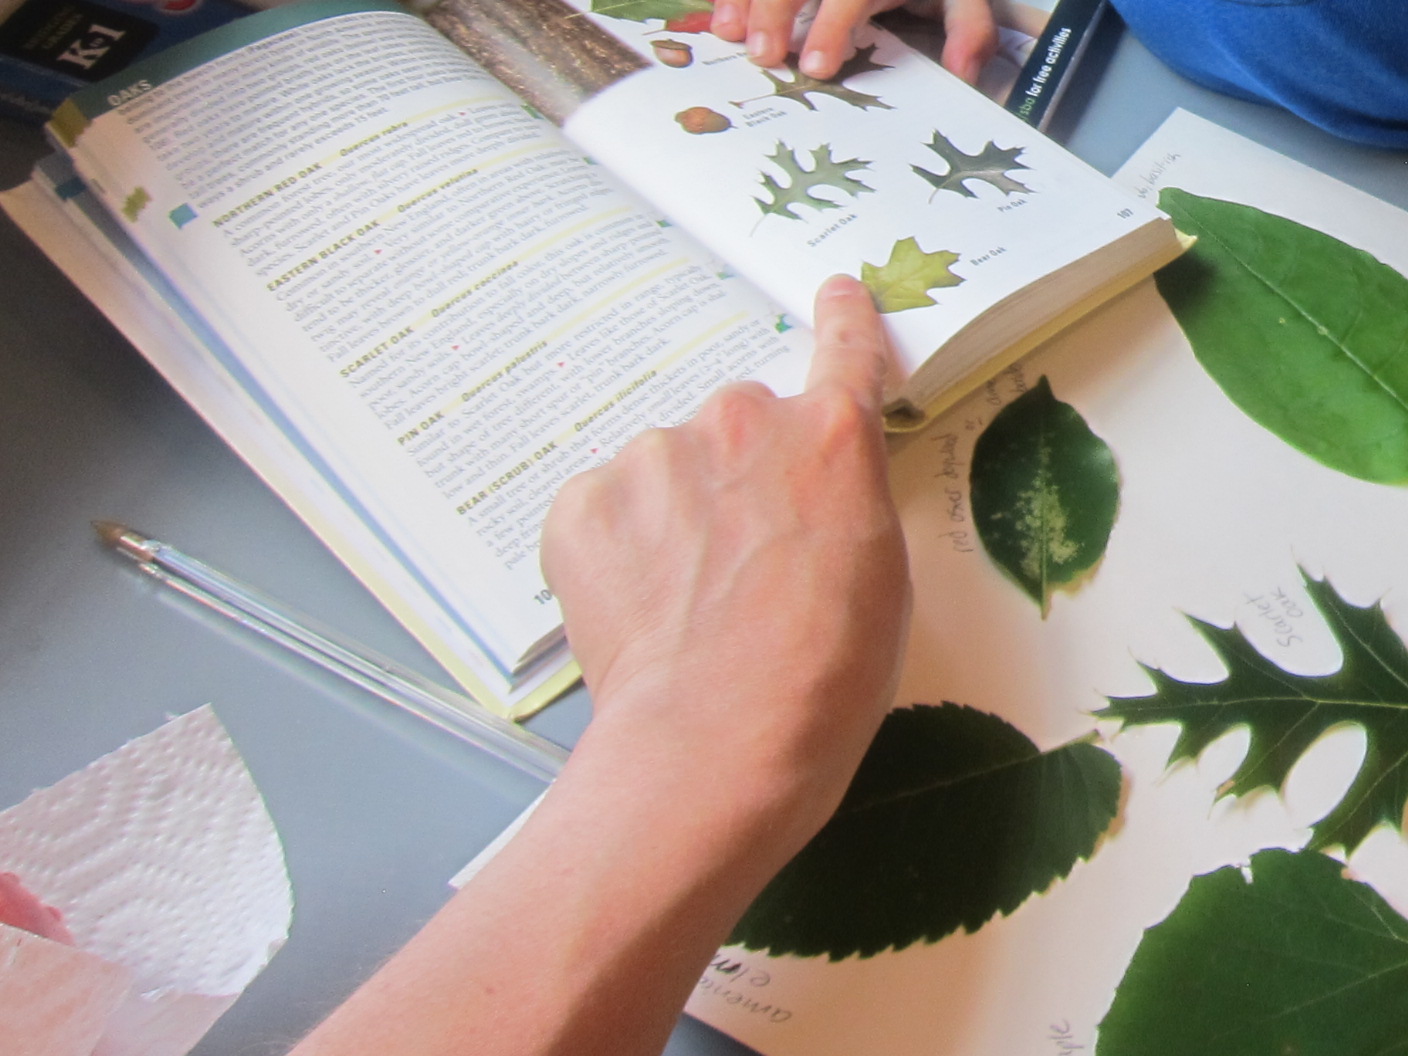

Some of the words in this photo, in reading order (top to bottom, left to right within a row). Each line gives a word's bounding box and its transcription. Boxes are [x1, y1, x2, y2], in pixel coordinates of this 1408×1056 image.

[57, 39, 110, 70] K
[88, 24, 127, 41] 1
[1026, 82, 1042, 97] for
[1034, 64, 1053, 85] free
[1045, 27, 1072, 64] activities
[107, 79, 152, 106] OAKS
[212, 189, 274, 228] NORTHERN
[273, 176, 297, 192] RED
[298, 162, 322, 178] OAK
[339, 134, 380, 157] Quercus
[381, 121, 408, 136] rubra
[997, 203, 1011, 214] Pin
[1011, 197, 1028, 209] Oak
[1117, 208, 1134, 221] 107
[266, 257, 319, 292] EASTERN
[318, 233, 356, 259] BLACK
[355, 219, 380, 236] OAK
[397, 188, 438, 213] Quercus
[439, 168, 478, 190] velutina
[807, 221, 838, 248] Scarlet
[838, 212, 857, 228] Oak
[970, 253, 991, 267] Bear
[991, 245, 1007, 258] Oak
[339, 342, 388, 378] SCARLET
[389, 325, 414, 344] OAK
[430, 289, 472, 318] Quercus
[474, 260, 519, 290] coccinea
[397, 427, 420, 446] PIN
[419, 410, 445, 430] OAK
[461, 371, 503, 402] Quercus
[504, 340, 548, 375] palustris
[456, 490, 488, 515] BEAR
[488, 458, 533, 493] (SCRUB)
[533, 441, 558, 460] OAK
[574, 401, 615, 432] Quercus
[616, 369, 657, 402] ilicifolia
[534, 589, 554, 607] 10
[1243, 592, 1304, 649] Scarlet
[1270, 586, 1304, 619] Oak
